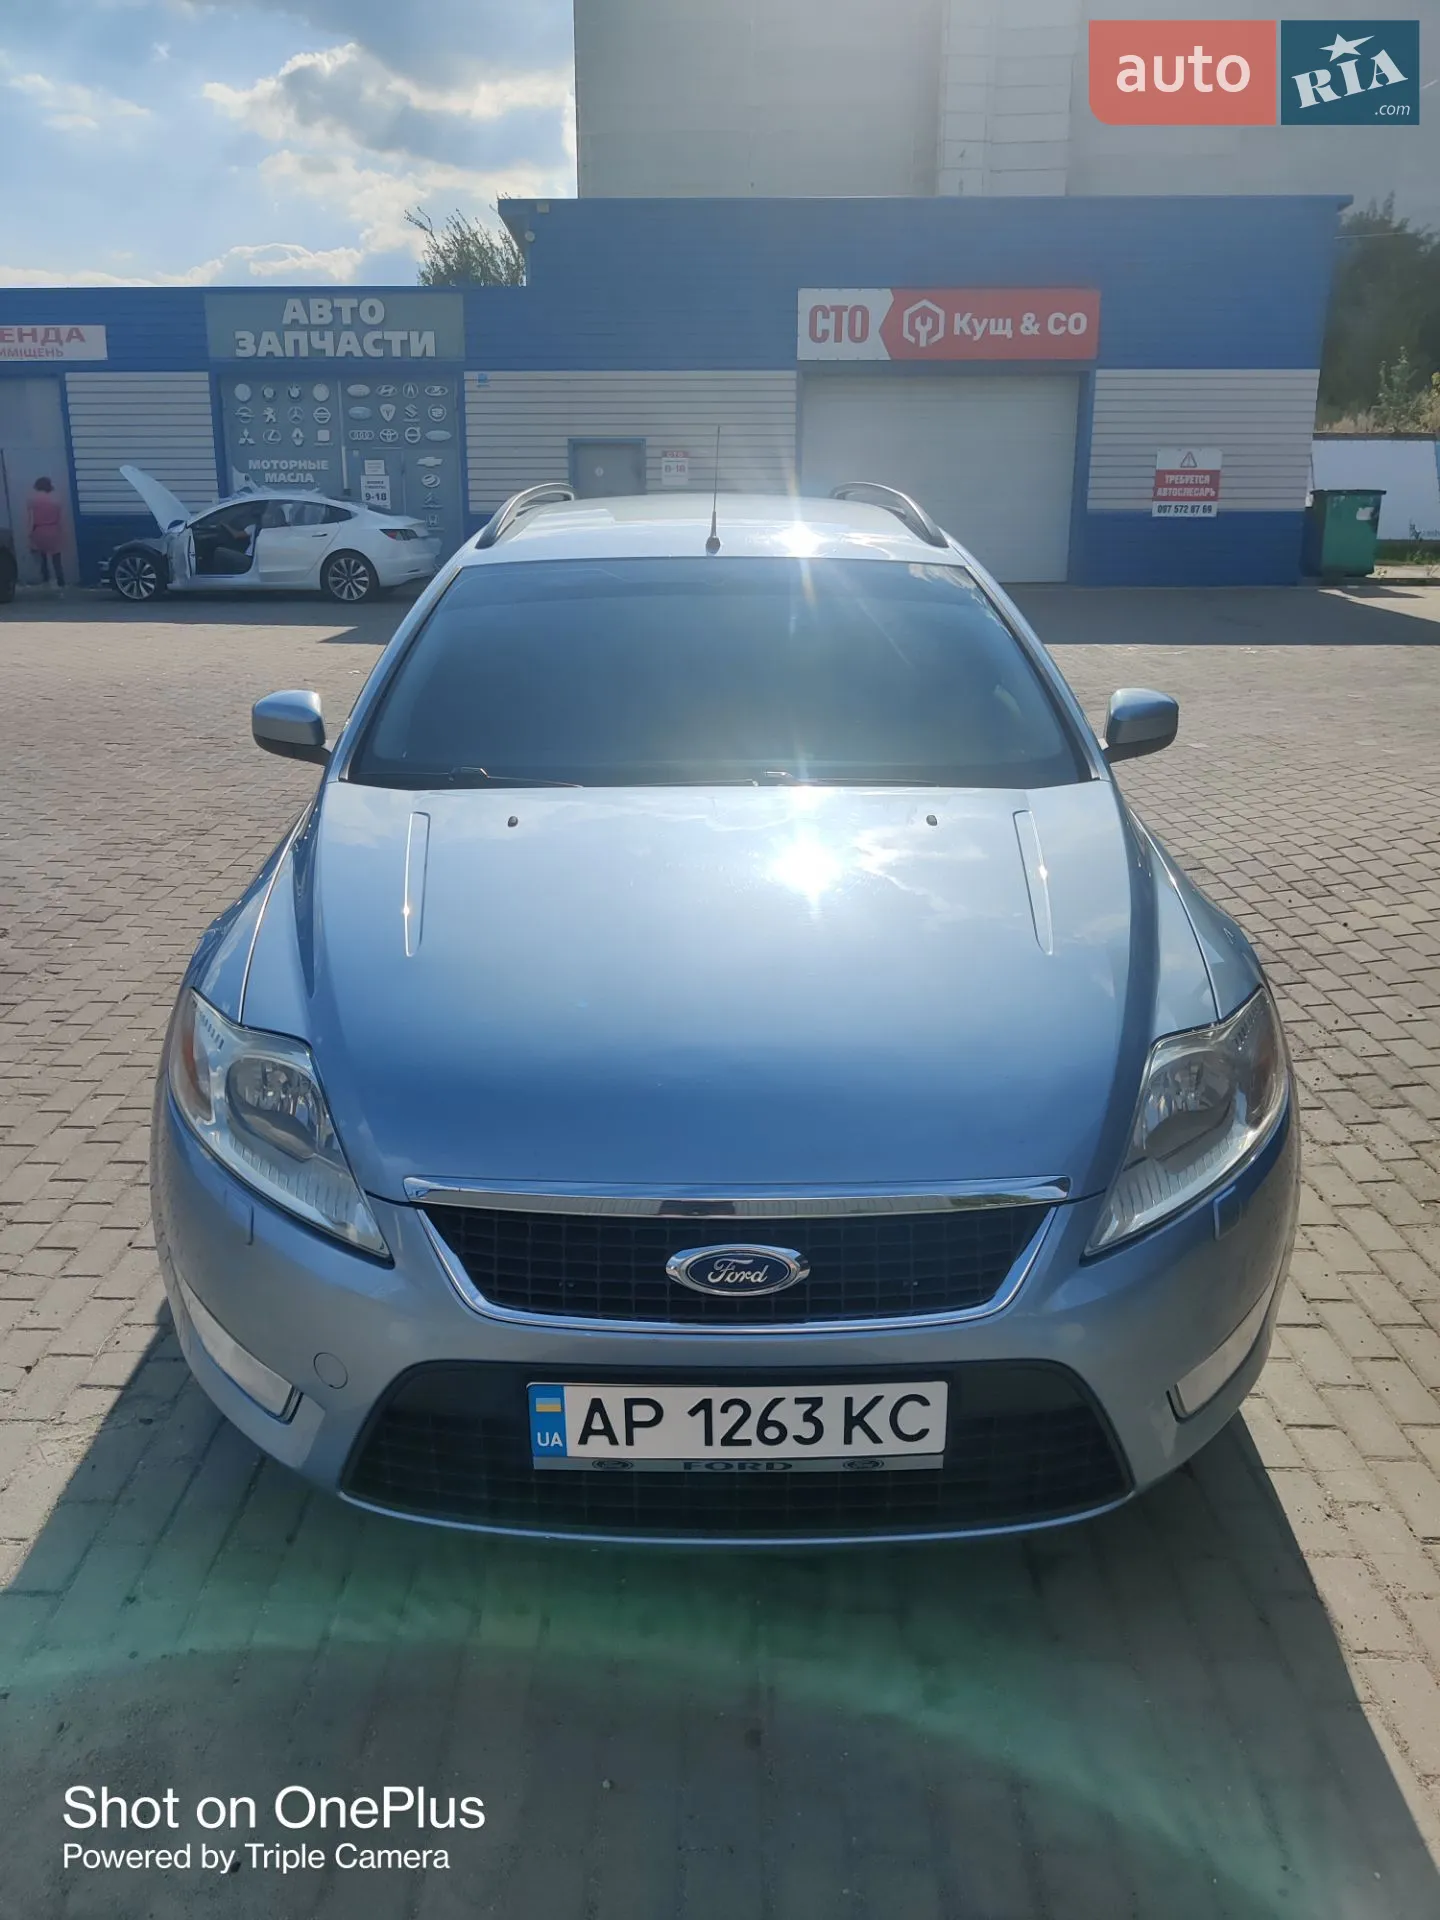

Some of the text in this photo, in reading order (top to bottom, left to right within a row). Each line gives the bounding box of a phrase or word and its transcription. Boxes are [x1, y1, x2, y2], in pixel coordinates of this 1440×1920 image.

[282, 298, 386, 326] АВТО
[808, 304, 870, 343] СТО
[953, 312, 1013, 341] Кущ
[1019, 312, 1041, 336] &
[235, 330, 436, 358] ЗАПЧАСТИ
[248, 459, 329, 470] МОТОРНЫЕ
[264, 472, 315, 483] МАСЛА
[365, 492, 387, 501] 9-18
[707, 1258, 770, 1284] Ford
[577, 1394, 931, 1447] AP 1263 KC
[536, 1431, 563, 1447] UA
[683, 1461, 793, 1472] FORD
